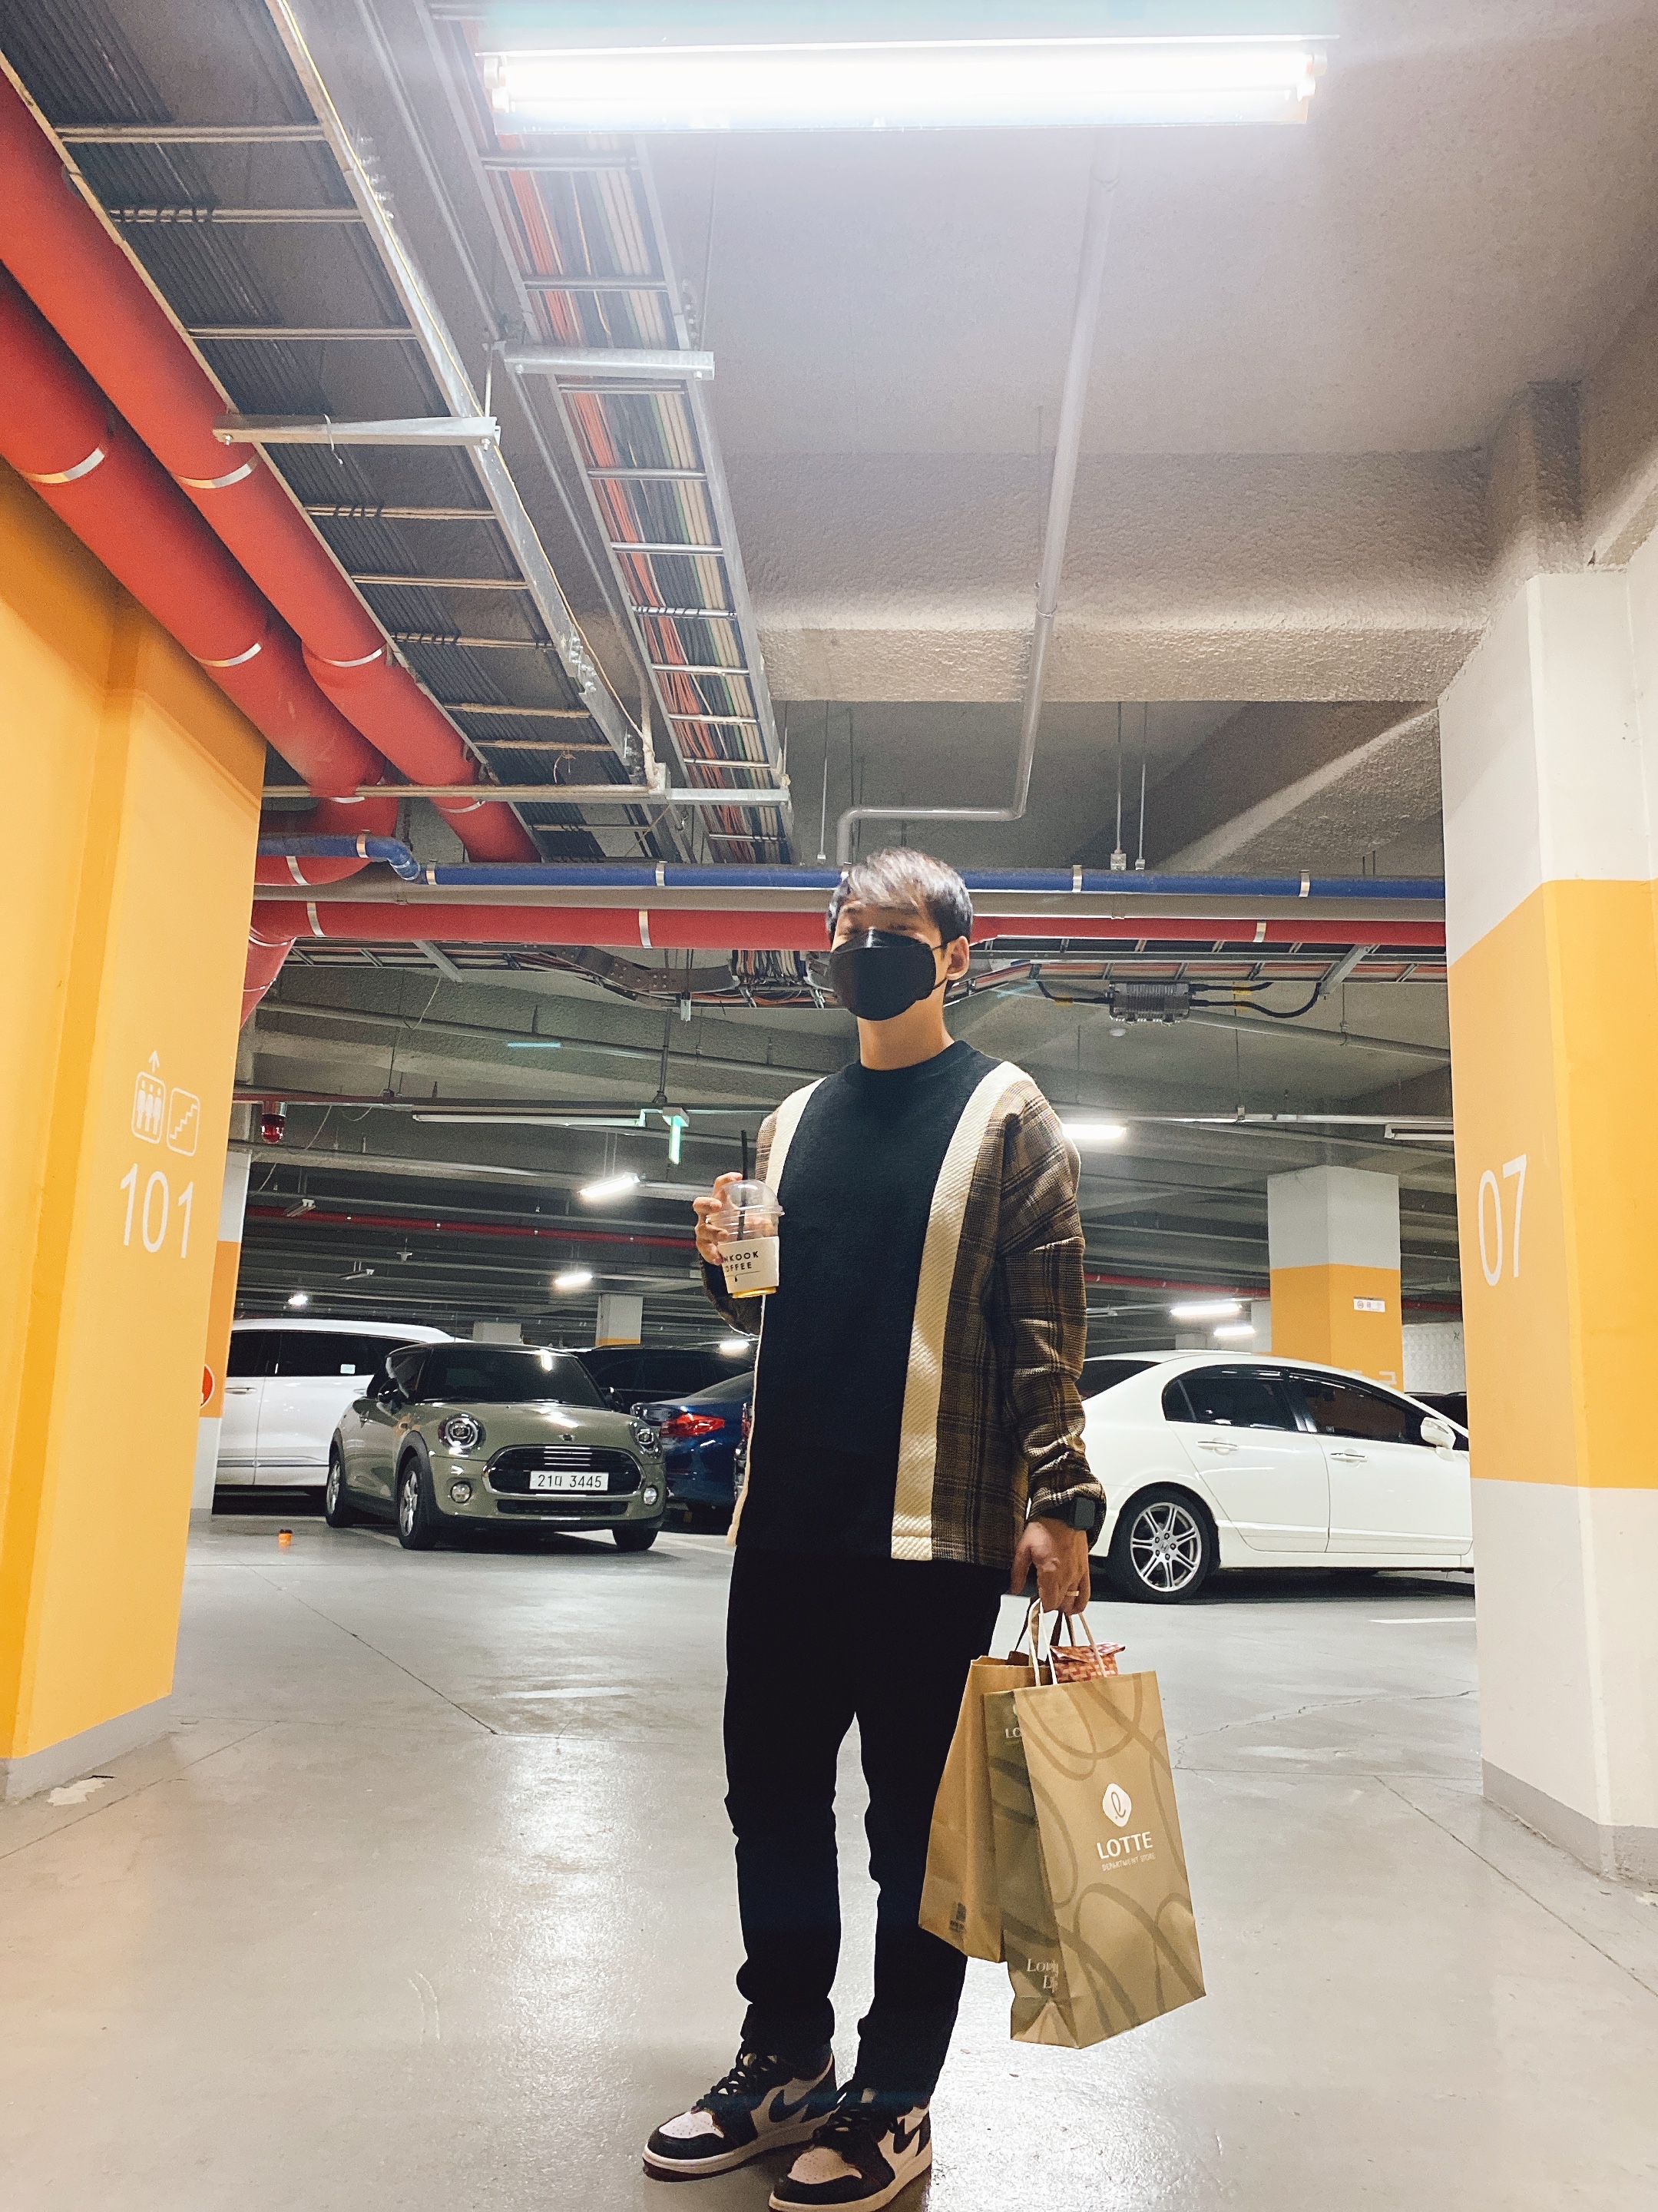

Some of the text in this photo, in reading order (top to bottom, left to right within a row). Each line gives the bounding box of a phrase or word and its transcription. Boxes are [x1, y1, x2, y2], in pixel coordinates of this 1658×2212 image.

[120, 1162, 194, 1260] 101
[1478, 1154, 1527, 1286] 07
[569, 1475, 602, 1488] 3445
[1096, 1831, 1153, 1859] LOTTE
